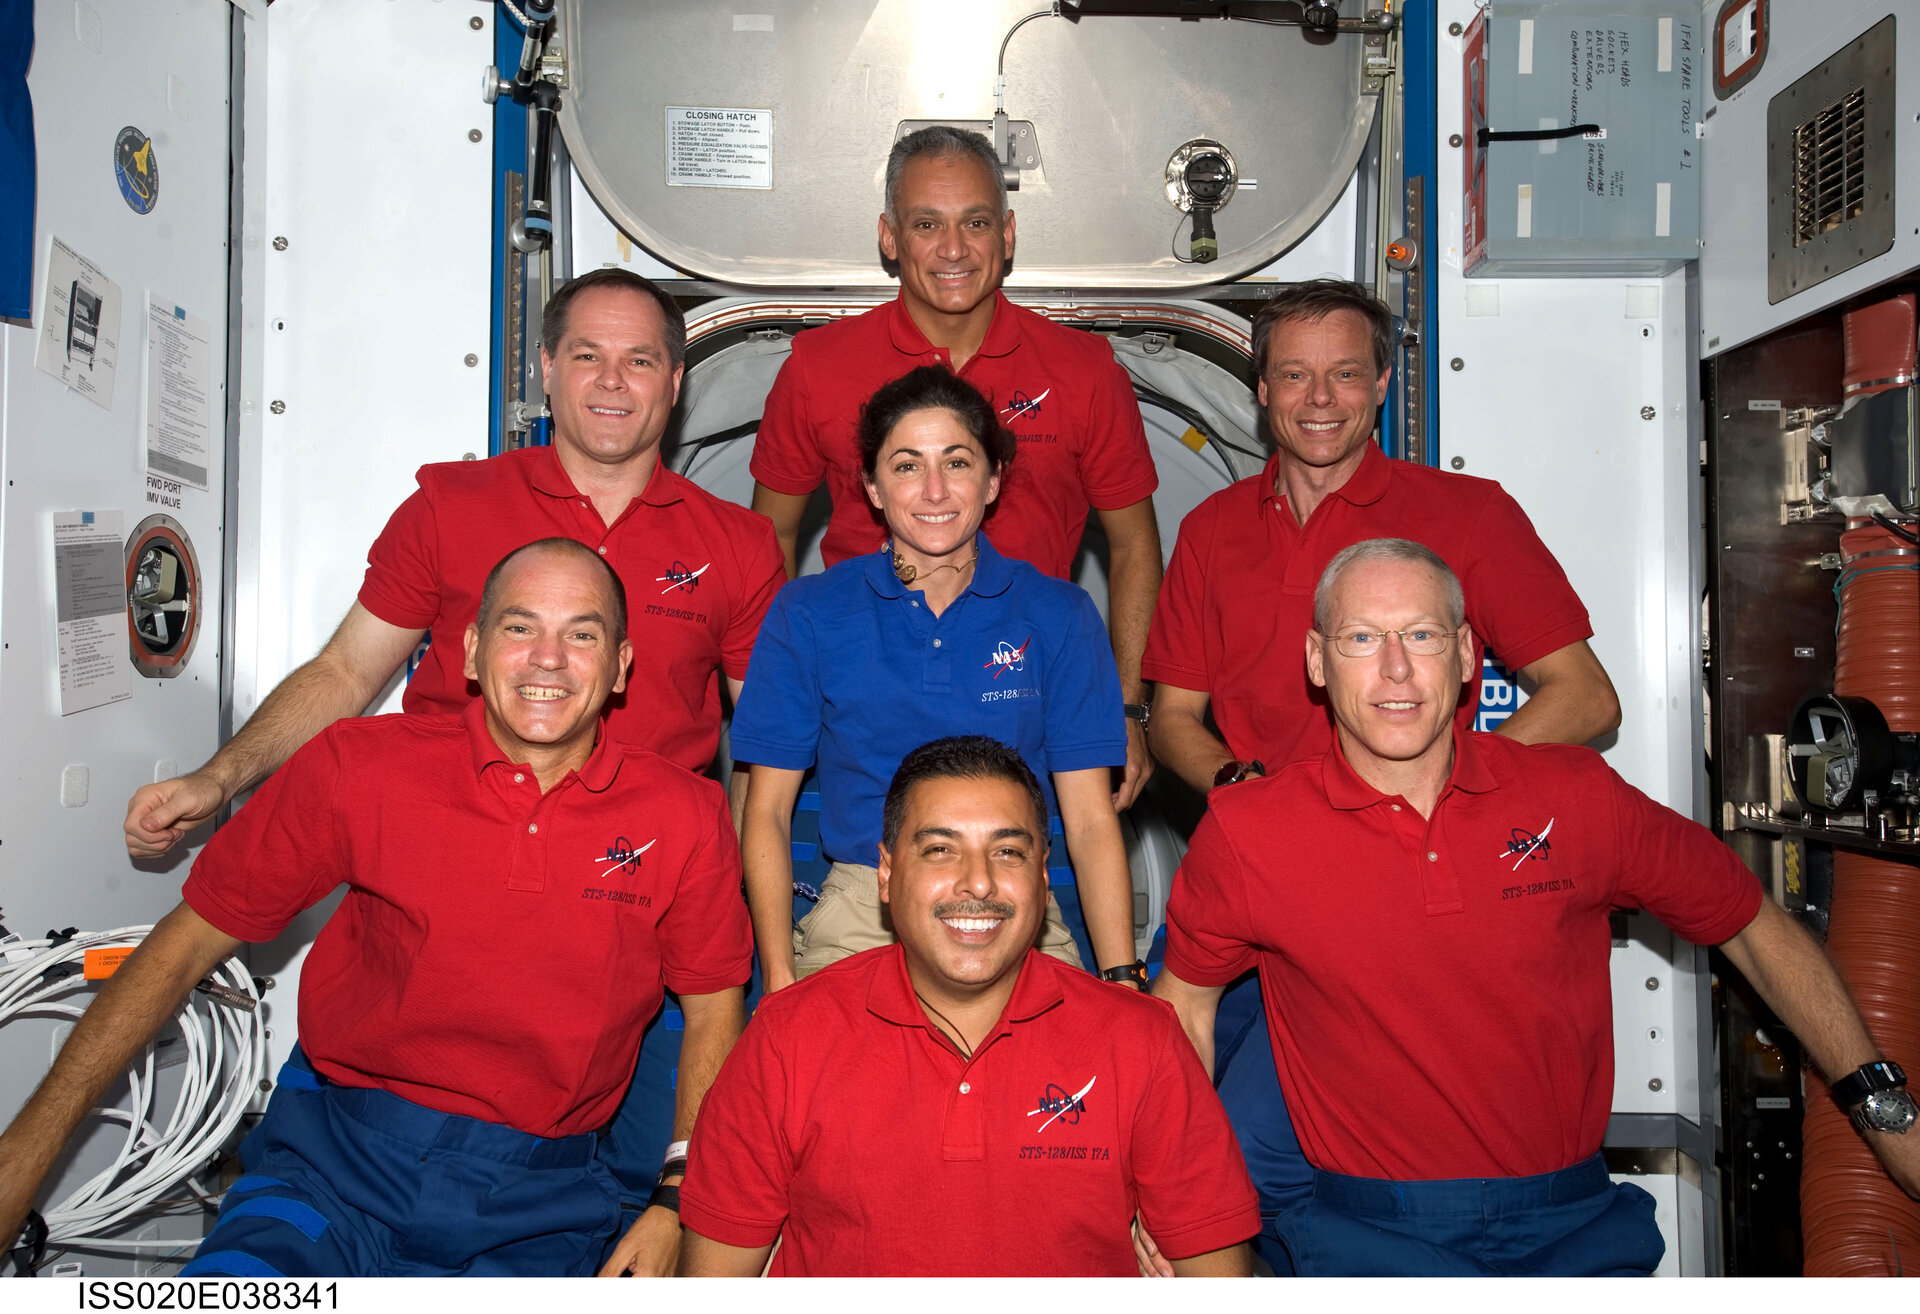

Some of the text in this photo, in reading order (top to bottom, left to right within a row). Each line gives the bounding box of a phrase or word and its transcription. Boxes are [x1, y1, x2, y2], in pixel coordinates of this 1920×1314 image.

[1681, 23, 1692, 50] IFM
[1570, 30, 1580, 86] COMBINATION
[1585, 30, 1594, 92] EXTENSIONS
[1596, 30, 1604, 76] DRIVERS
[1607, 30, 1616, 74] SOCKETS
[1618, 31, 1631, 88] HEX HEADS
[1681, 56, 1692, 91] SPARE
[686, 111, 724, 120] CLOSING
[1681, 99, 1692, 134] TOOLS
[1596, 143, 1605, 197] SCREWDRIVERS
[1680, 161, 1692, 170] 1
[146, 476, 182, 495] FWD PORT
[146, 492, 181, 509] IMV VALVE
[644, 604, 695, 621] STS-128/ISS
[582, 888, 651, 908] STS-128/ISS 17A
[1502, 879, 1560, 900] STS-128/ISS
[1019, 1146, 1110, 1160] STS-128/ISS 17A
